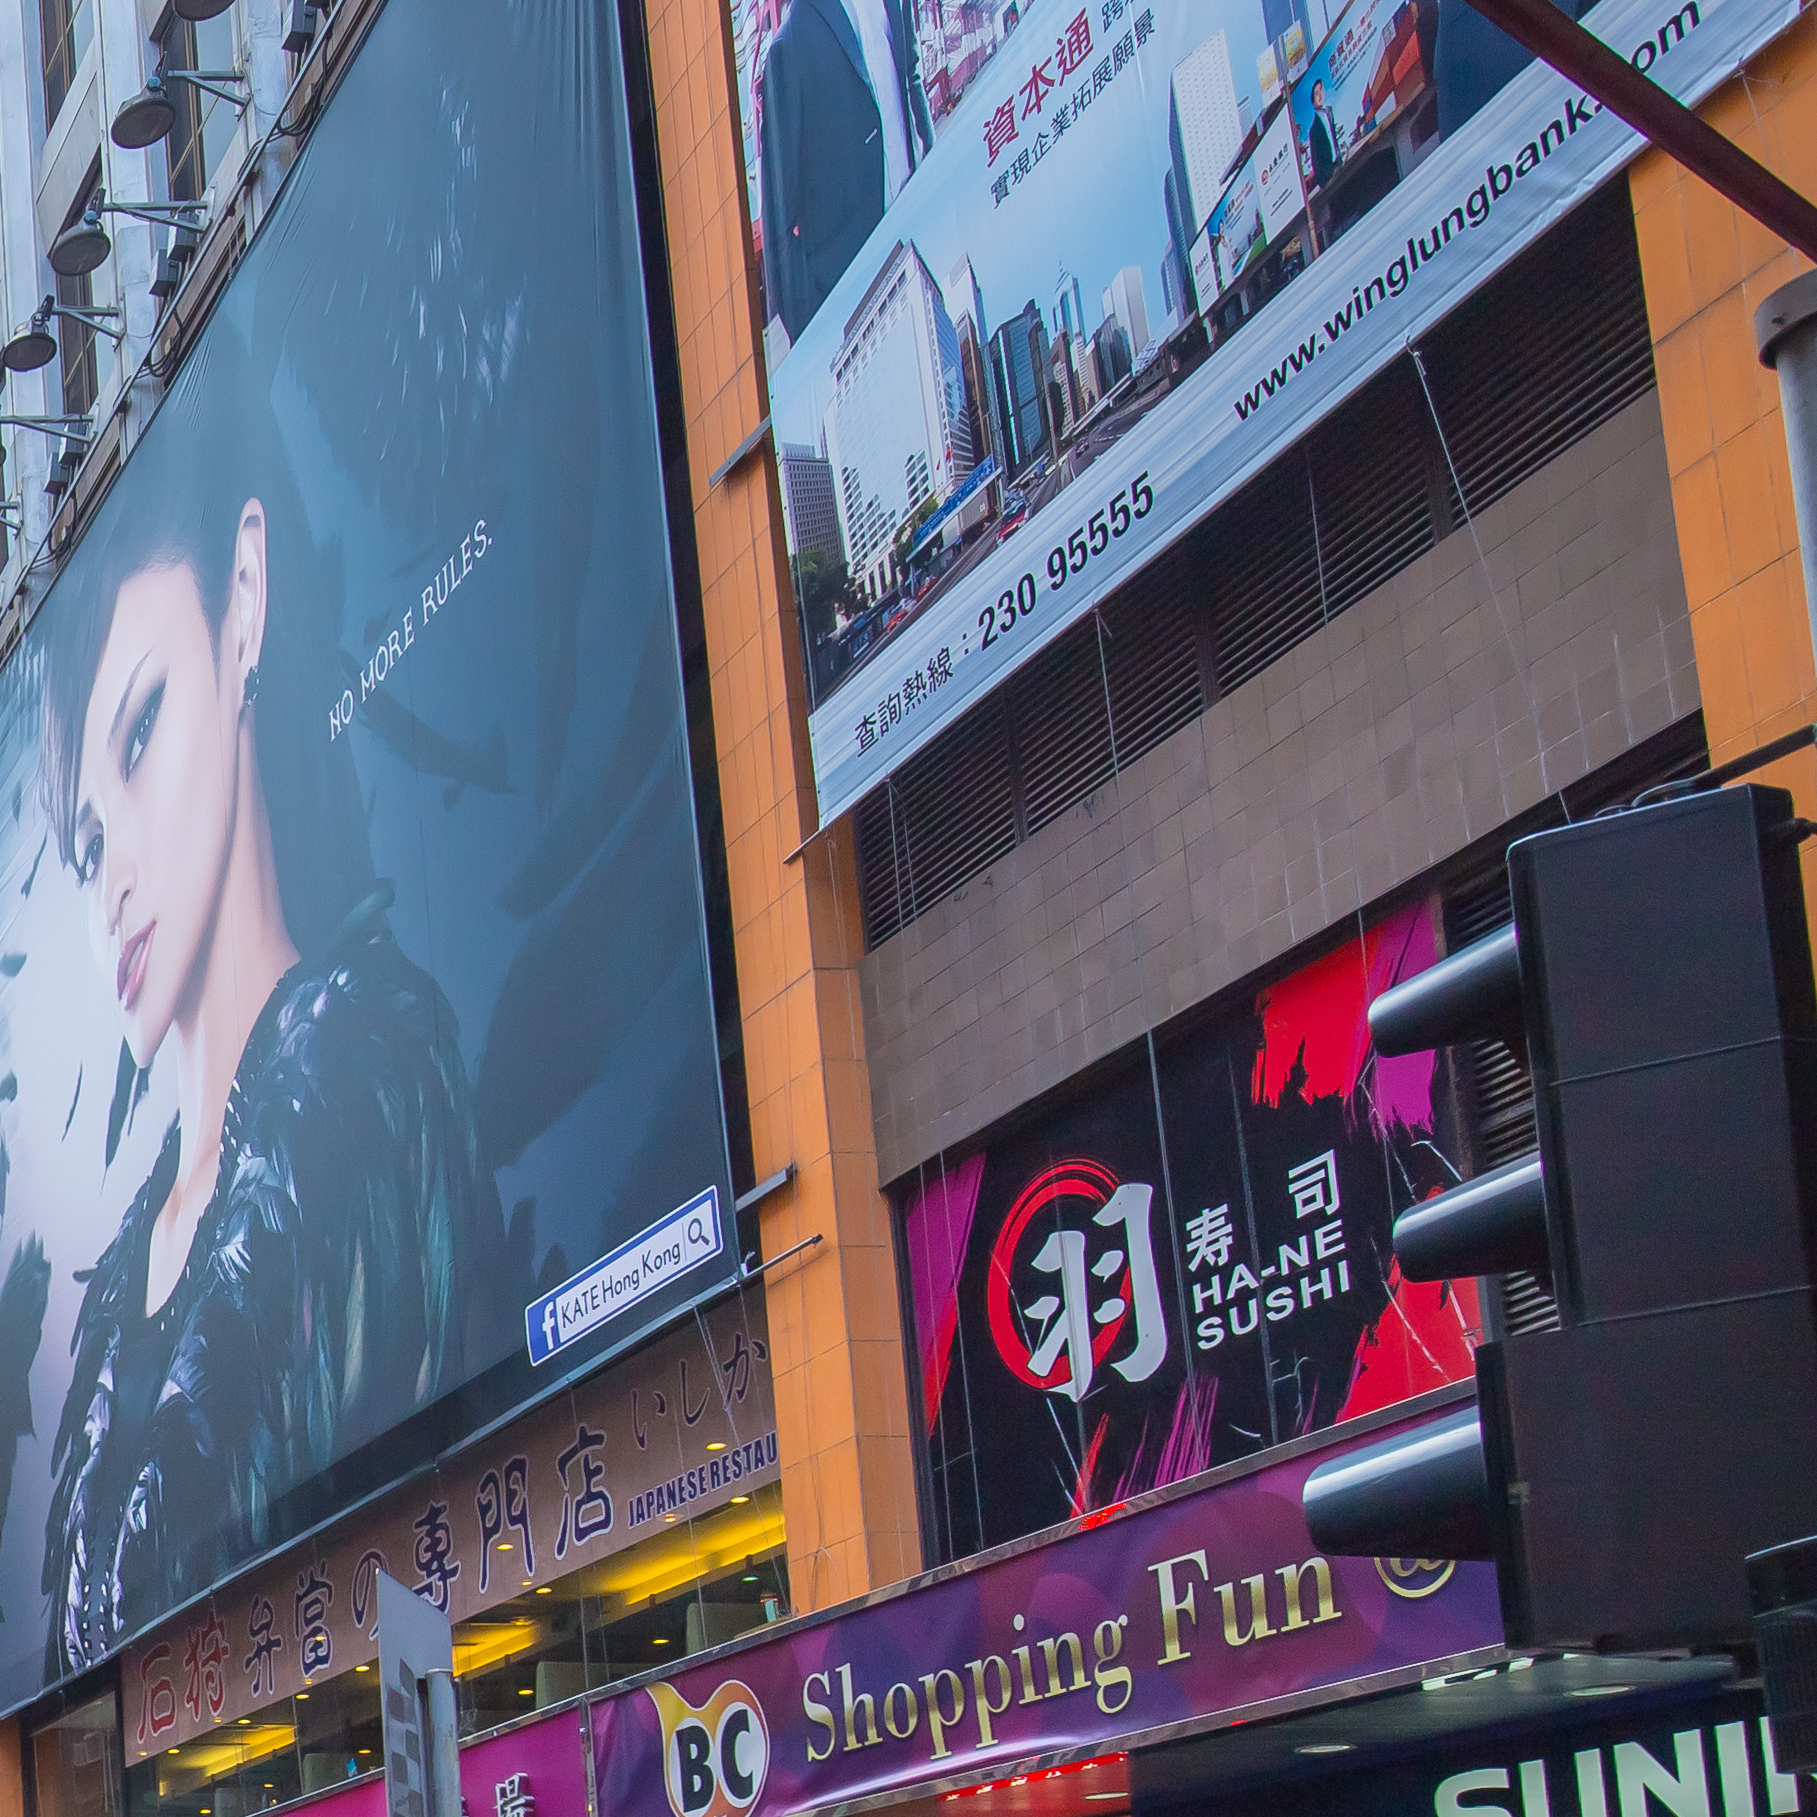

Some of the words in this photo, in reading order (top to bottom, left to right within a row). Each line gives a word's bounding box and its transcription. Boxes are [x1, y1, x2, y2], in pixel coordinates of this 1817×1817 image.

[983, 7, 1094, 168] 資本通
[990, 8, 1155, 209] 實現企業拓展願景
[1232, 2, 1700, 421] www.winglungbank.om
[977, 574, 1037, 656] 230
[1047, 467, 1157, 593] 95555
[328, 689, 354, 743] NO
[359, 606, 415, 704] MORE
[561, 1284, 601, 1329] KATE
[602, 1268, 640, 1302] Hong
[642, 1242, 681, 1279] Kong
[1191, 1219, 1347, 1315] HA-NE
[1196, 1259, 1352, 1351] SUSHI
[628, 1459, 708, 1529] JAPANESE
[708, 1431, 779, 1492] RESTAU
[802, 1611, 1131, 1761] Shopping
[1148, 1547, 1342, 1666] Fun
[677, 1707, 753, 1817] BC
